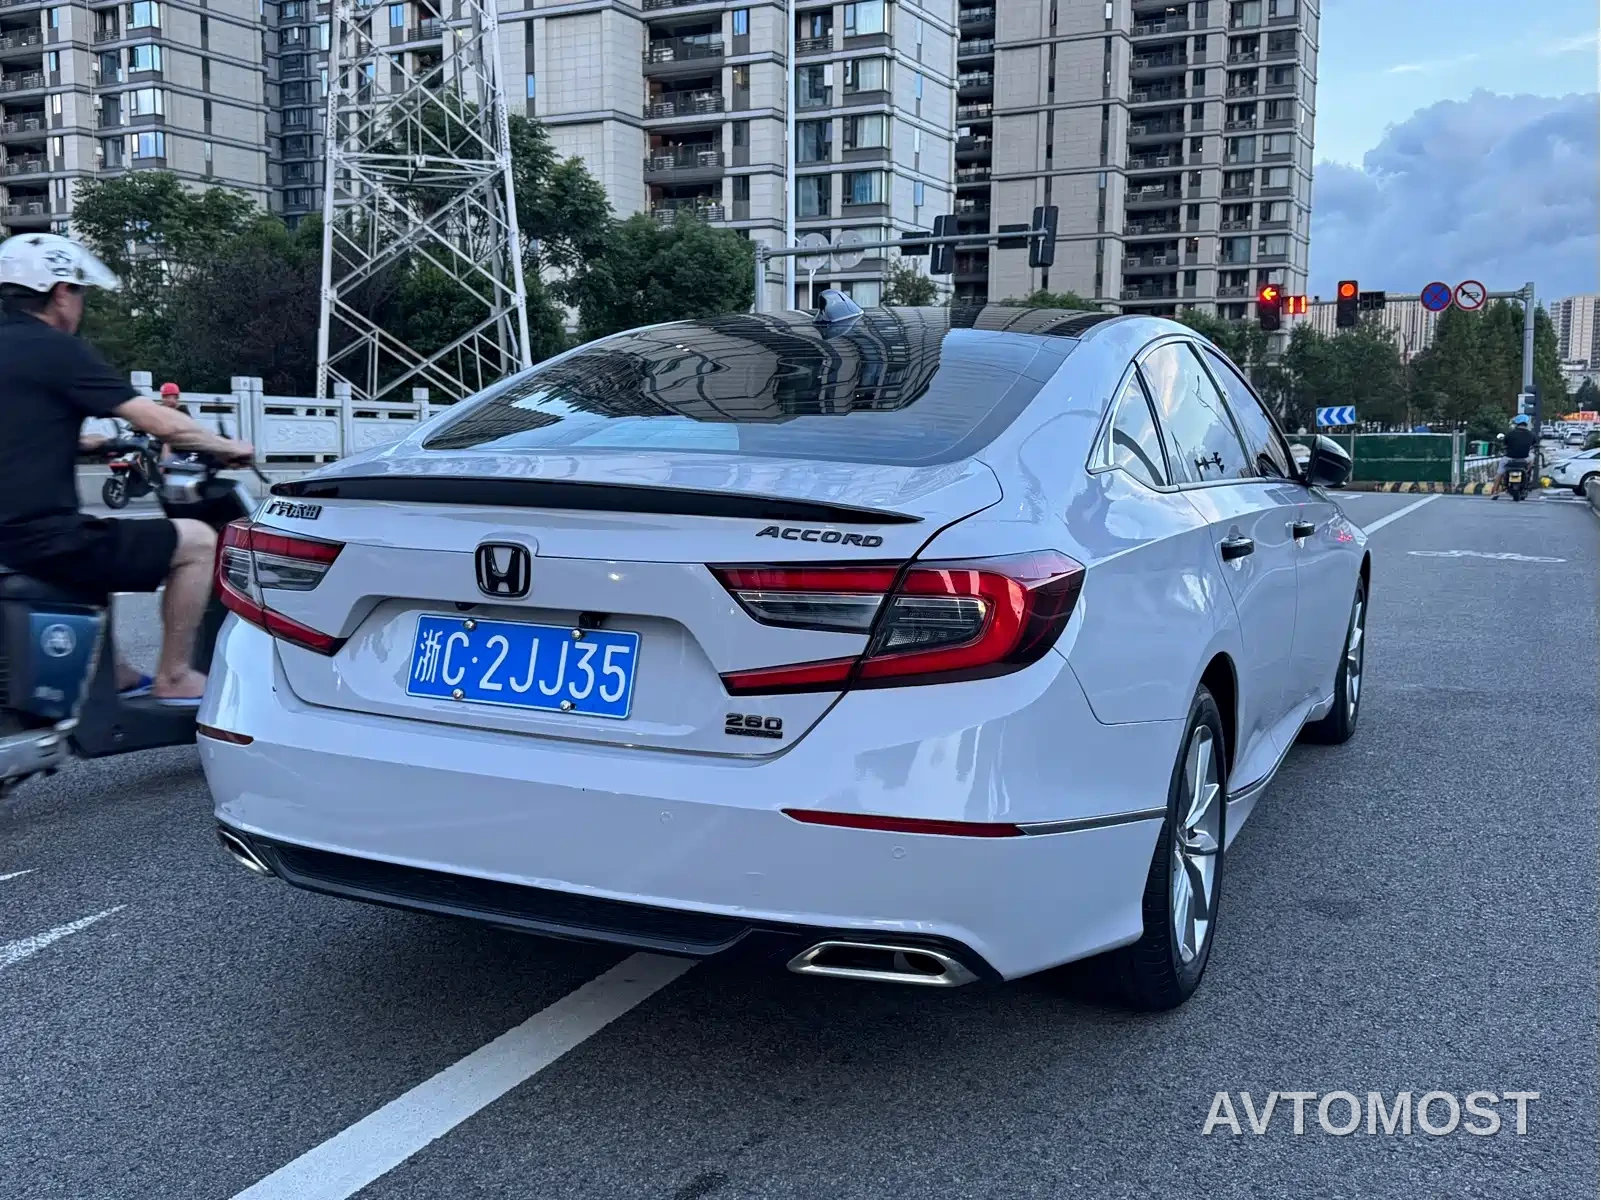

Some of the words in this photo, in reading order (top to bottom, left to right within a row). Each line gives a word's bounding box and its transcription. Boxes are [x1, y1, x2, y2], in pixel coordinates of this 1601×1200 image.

[266, 501, 322, 520] 广汽本田
[755, 526, 883, 547] ACCORD
[725, 712, 783, 730] 260
